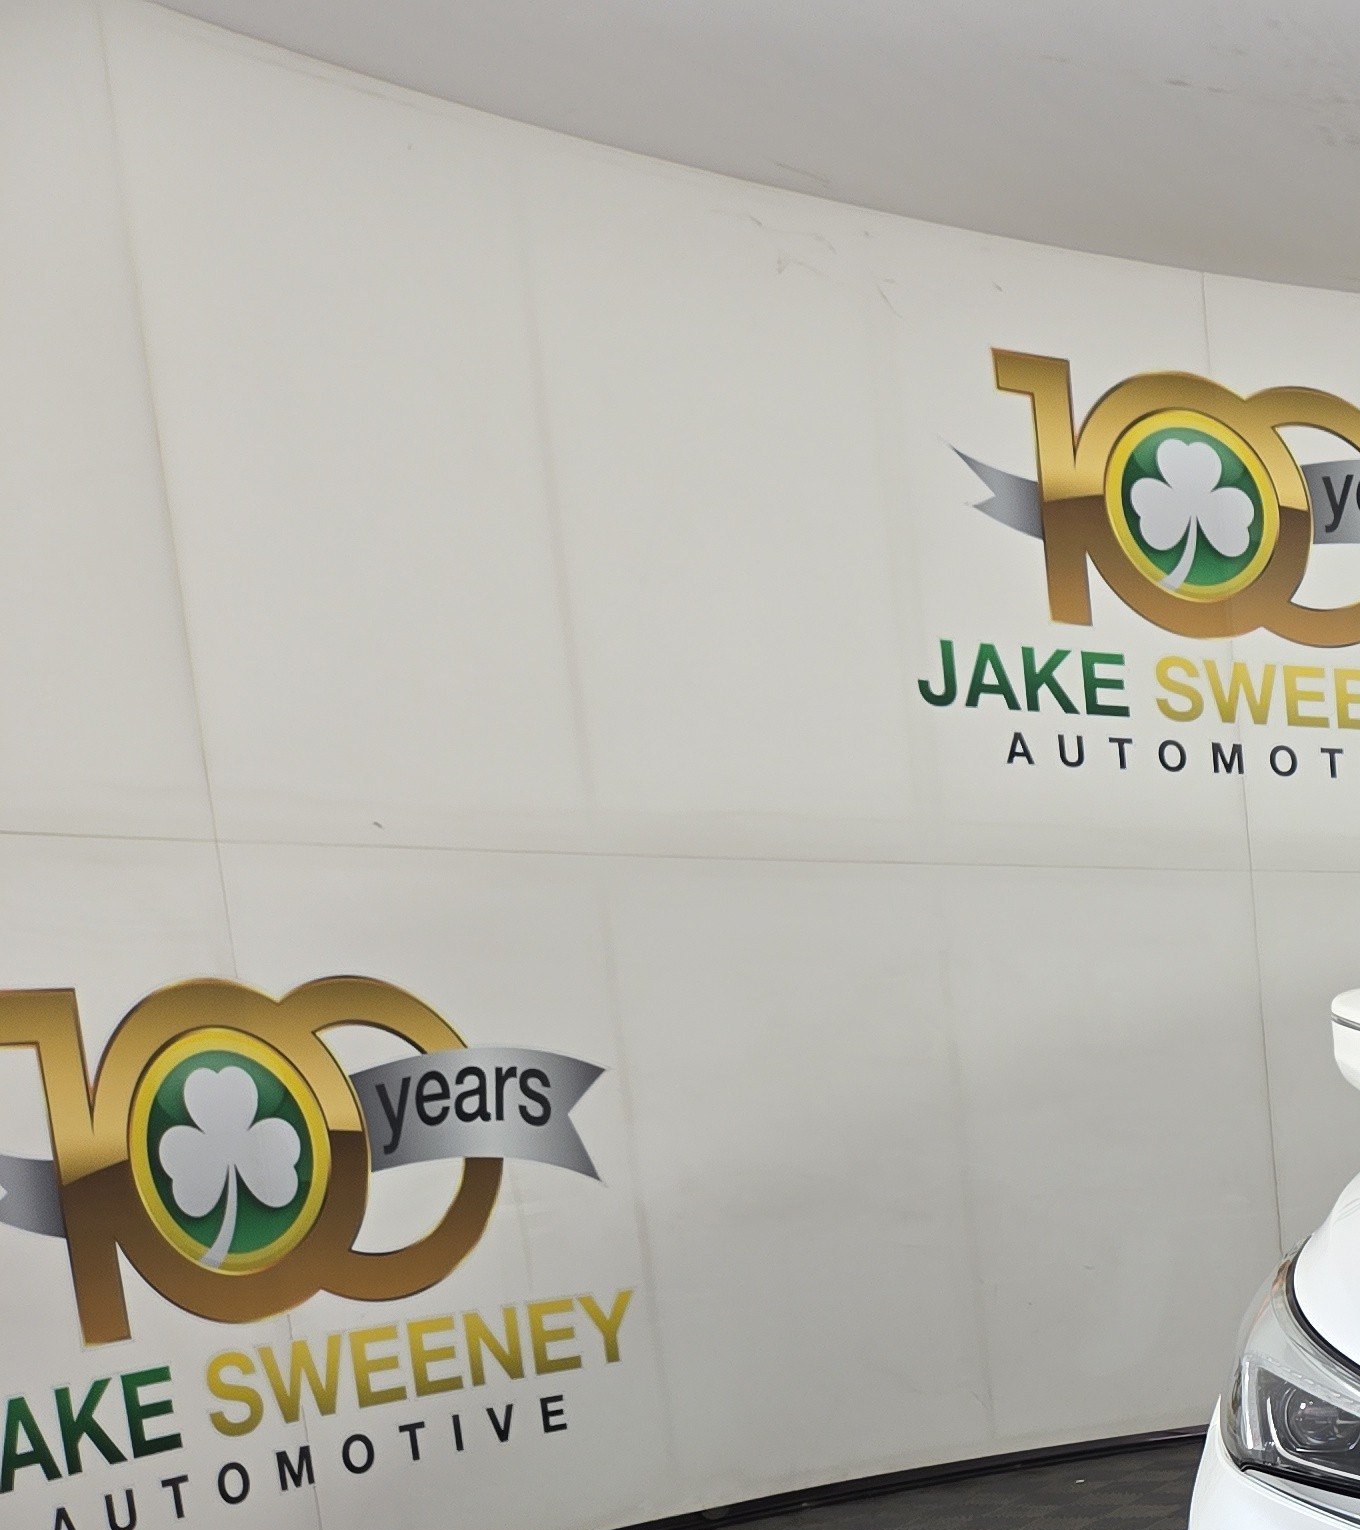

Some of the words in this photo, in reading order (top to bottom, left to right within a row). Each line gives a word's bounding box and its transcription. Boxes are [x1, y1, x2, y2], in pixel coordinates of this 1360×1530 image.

[917, 638, 1132, 718] JAKE
[374, 1064, 554, 1156] years
[0, 1364, 184, 1496] AKE
[205, 1290, 635, 1438] SWEENEY
